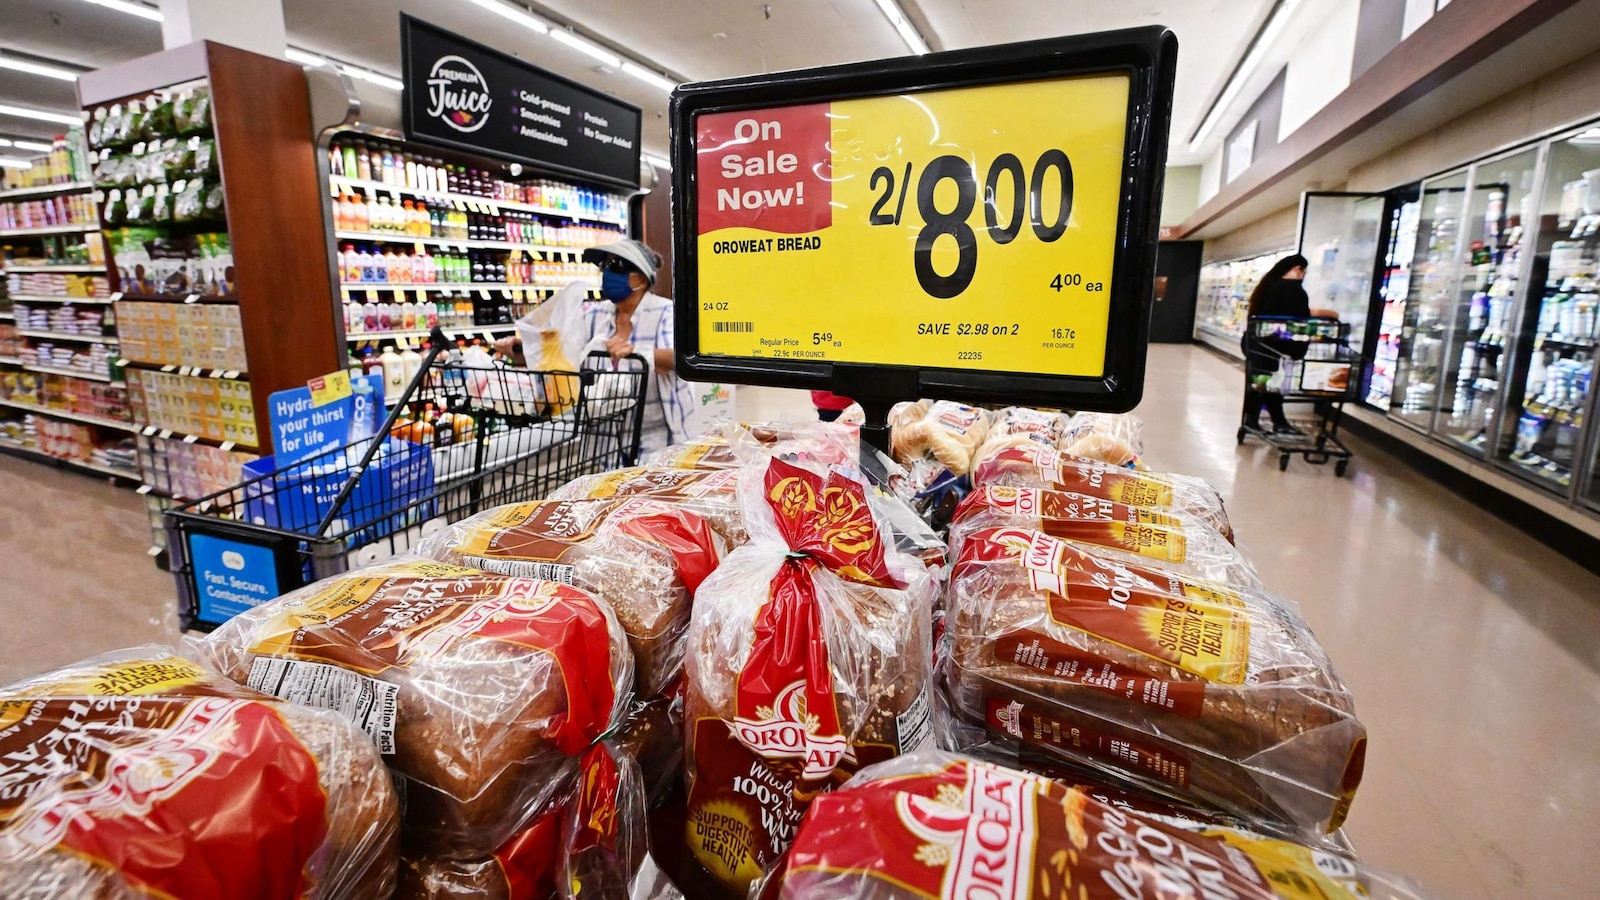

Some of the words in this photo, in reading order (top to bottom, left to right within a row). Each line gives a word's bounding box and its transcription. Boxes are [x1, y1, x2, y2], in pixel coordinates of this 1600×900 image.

[438, 67, 478, 84] PREMIUM
[427, 79, 493, 118] Juice
[519, 90, 571, 116] Cold-pressed
[519, 107, 562, 129] Smoothies
[583, 112, 608, 127] Protein
[519, 125, 569, 147] Antioxidants
[583, 126, 595, 138] No
[594, 129, 613, 145] Sugar
[613, 134, 632, 149] Added
[734, 118, 782, 144] On
[721, 150, 799, 179] Sale
[717, 181, 804, 212] Now!
[713, 238, 773, 254] OROWEAT
[777, 236, 821, 251] BREAD
[1086, 282, 1103, 292] ea
[703, 302, 713, 311] 24
[716, 302, 729, 311] OZ
[917, 323, 950, 336] SAVE
[956, 323, 989, 337] $2.98
[992, 326, 1008, 335] on
[1011, 323, 1020, 336] 2
[760, 338, 783, 347] Regular
[783, 338, 799, 346] Price
[958, 351, 982, 360] 22235
[278, 418, 309, 439] your
[311, 407, 344, 427] thirst
[281, 438, 301, 454] for
[303, 430, 325, 447] life
[229, 575, 269, 595] Secure.
[1158, 599, 1186, 651] SUPPORTS
[1179, 605, 1204, 657] DIGESTIVE
[1201, 620, 1224, 657] HEALTH
[383, 684, 398, 728] Nutrition
[381, 730, 392, 753] Facts
[695, 808, 754, 848] SUPPORTS
[696, 822, 749, 864] DIGESTIVE
[702, 838, 739, 875] HEALTH
